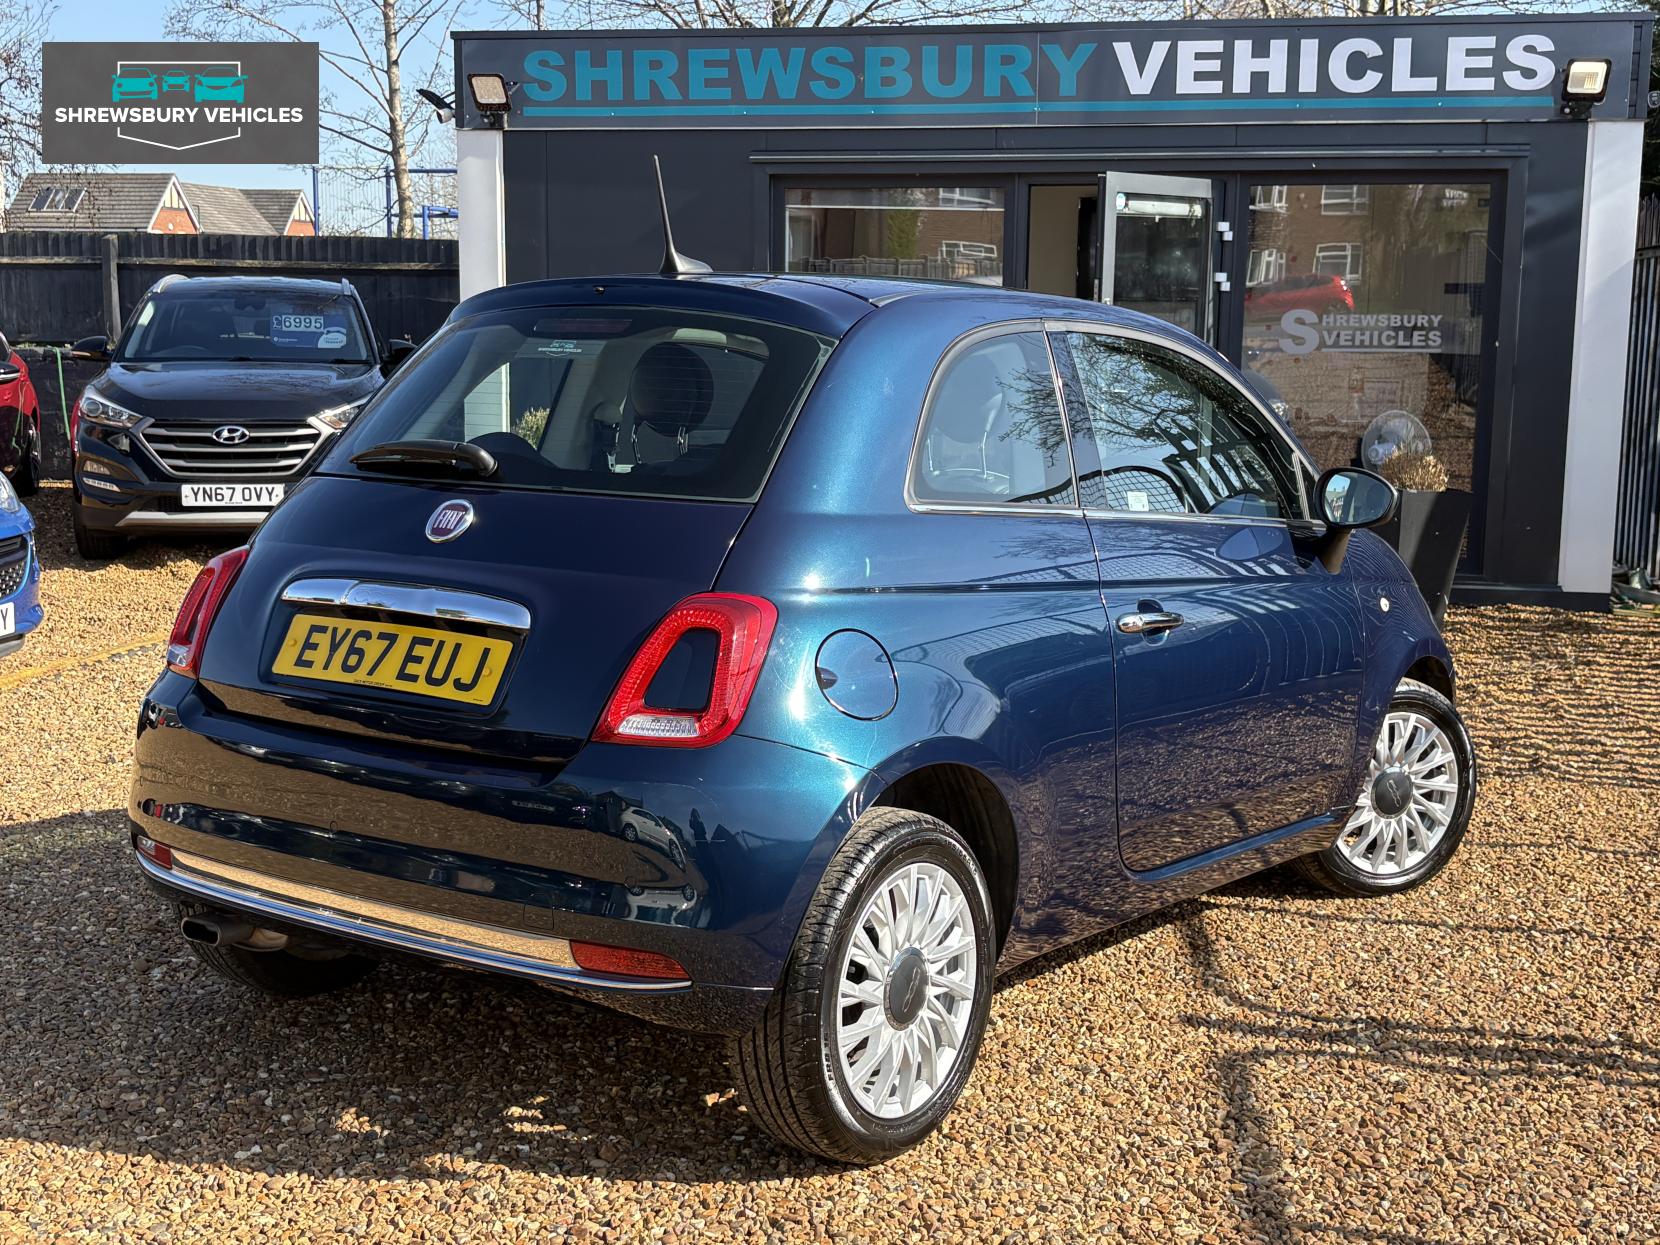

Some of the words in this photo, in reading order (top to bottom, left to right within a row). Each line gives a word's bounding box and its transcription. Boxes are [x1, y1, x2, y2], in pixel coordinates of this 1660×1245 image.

[522, 42, 1098, 102] SHREWSBURY
[1113, 35, 1556, 95] VEHICLES
[273, 315, 322, 330] £6995
[1322, 330, 1442, 346] VEHICLES
[191, 486, 236, 502] YN67
[241, 486, 275, 502] OVY
[433, 509, 466, 530] FIAT
[293, 623, 400, 677] EY67
[395, 635, 492, 693] EUJ
